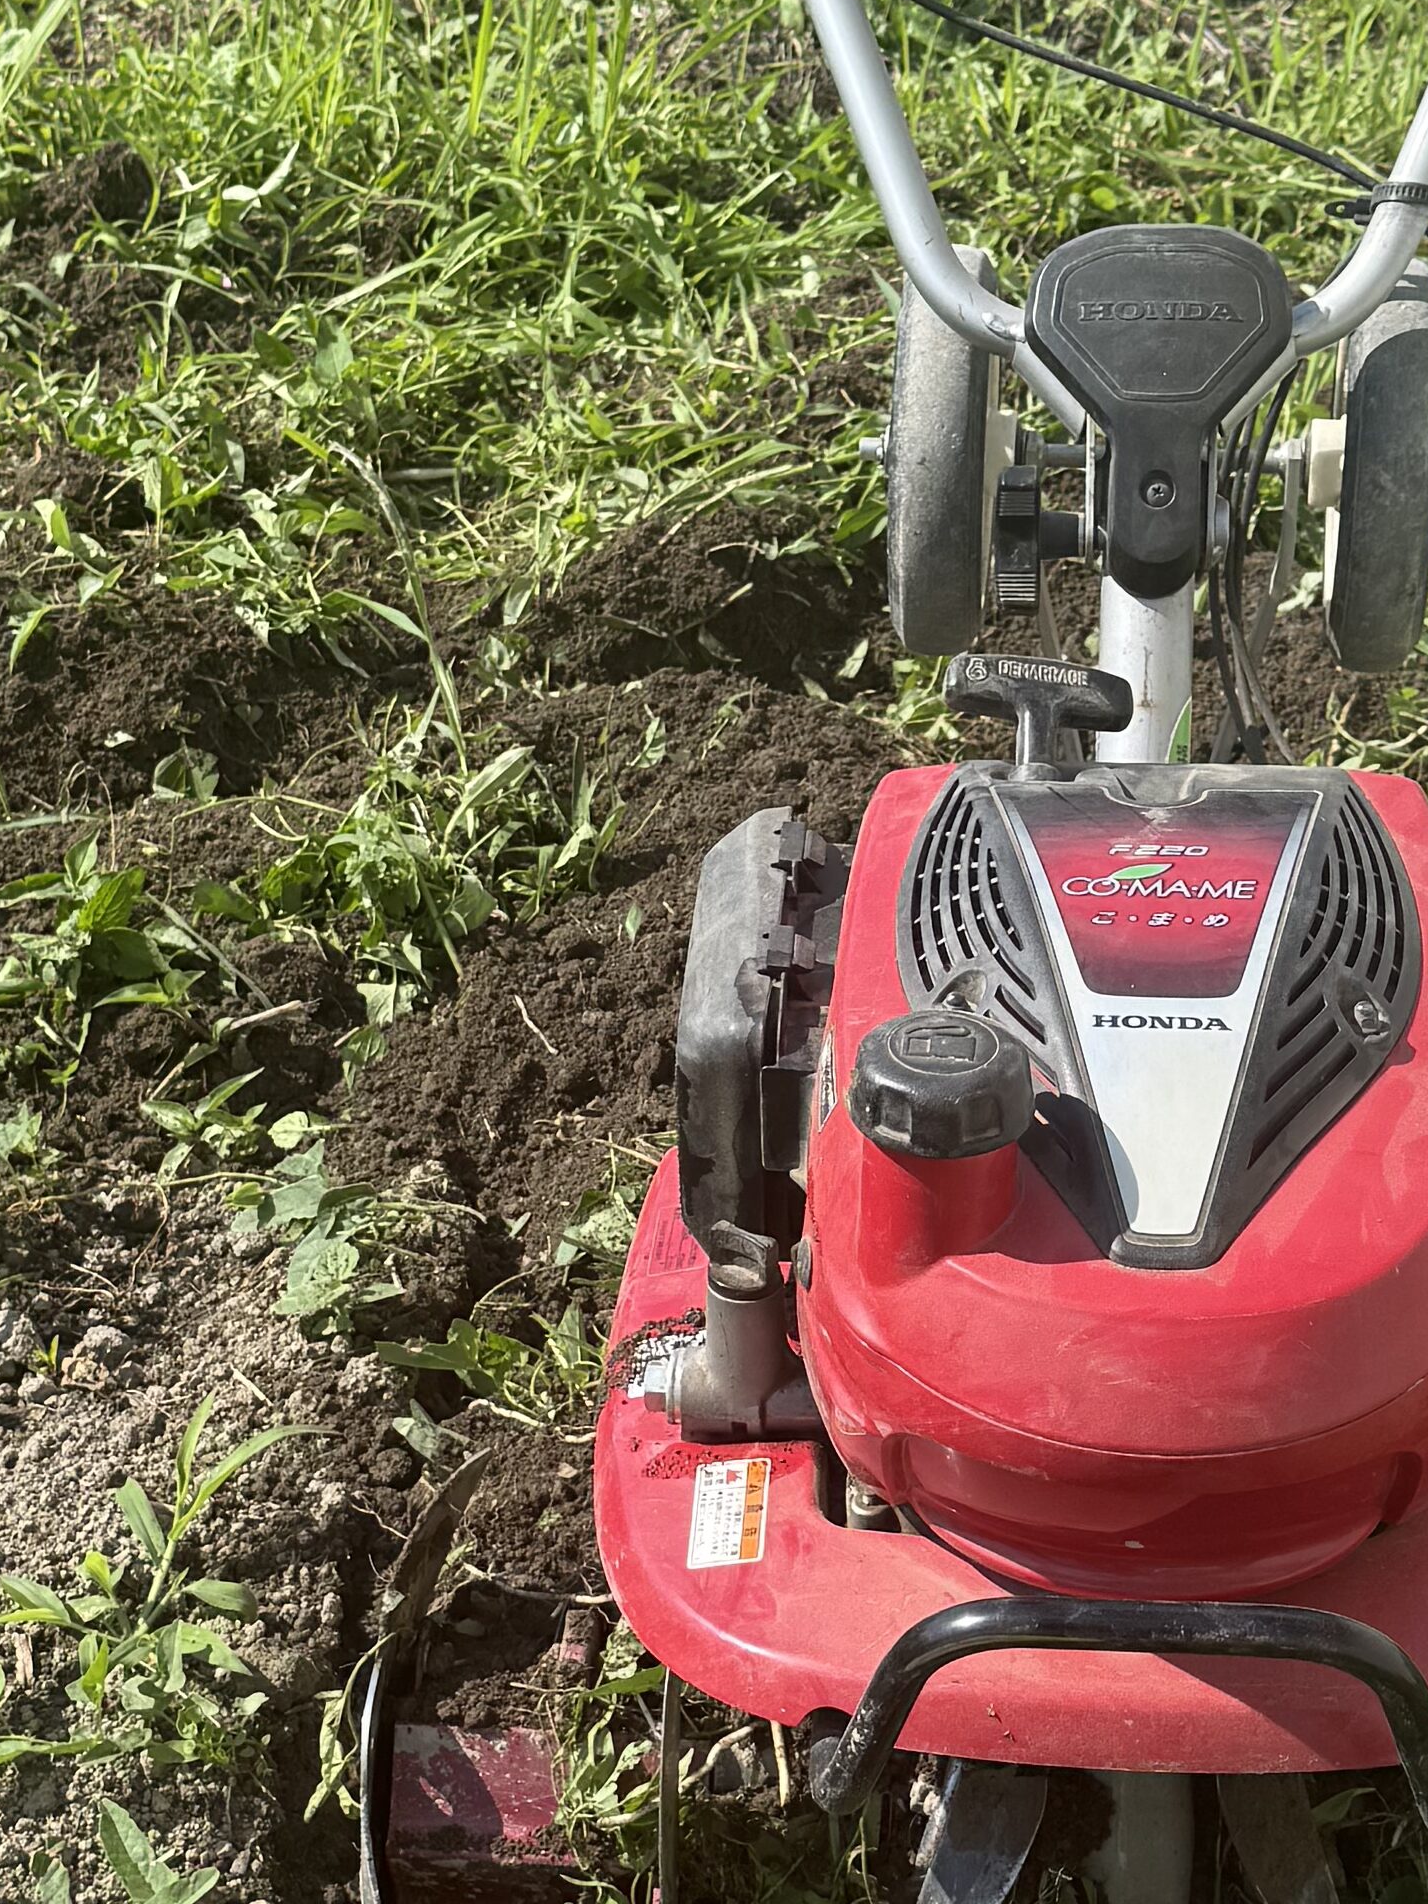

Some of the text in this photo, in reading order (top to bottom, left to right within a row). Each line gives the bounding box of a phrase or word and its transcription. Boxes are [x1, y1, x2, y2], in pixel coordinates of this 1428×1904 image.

[1078, 300, 1244, 322] HONDA
[1108, 844, 1209, 856] F220
[1092, 1014, 1233, 1031] HONDA
